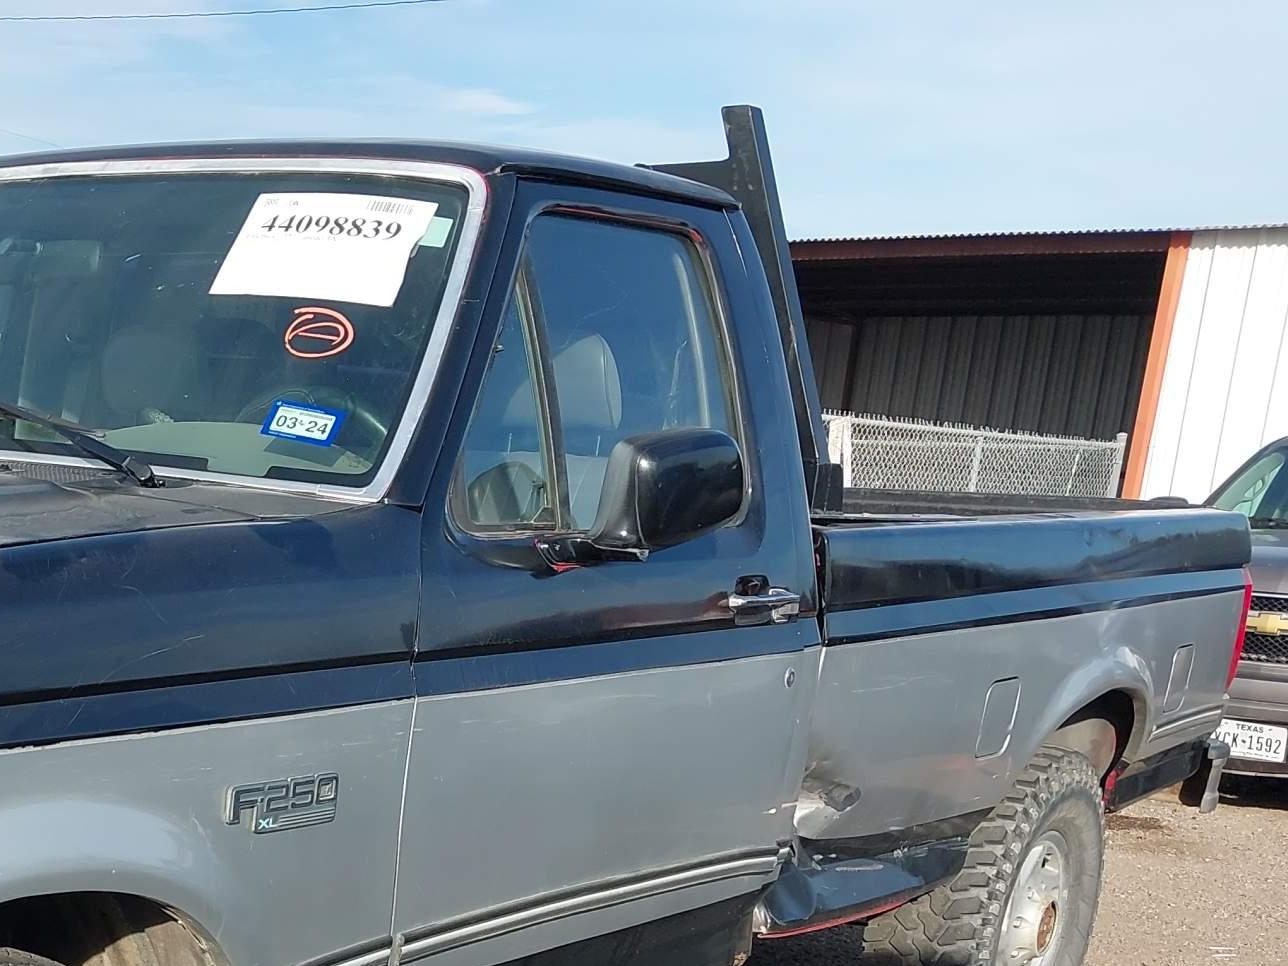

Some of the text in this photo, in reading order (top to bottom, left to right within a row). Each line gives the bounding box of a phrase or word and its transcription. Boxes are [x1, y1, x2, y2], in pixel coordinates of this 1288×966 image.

[261, 214, 402, 240] 44098839
[276, 415, 298, 429] 03
[305, 420, 329, 435] 24
[1236, 723, 1264, 733] TEXAS
[225, 773, 338, 824] F250
[258, 818, 277, 829] XL
